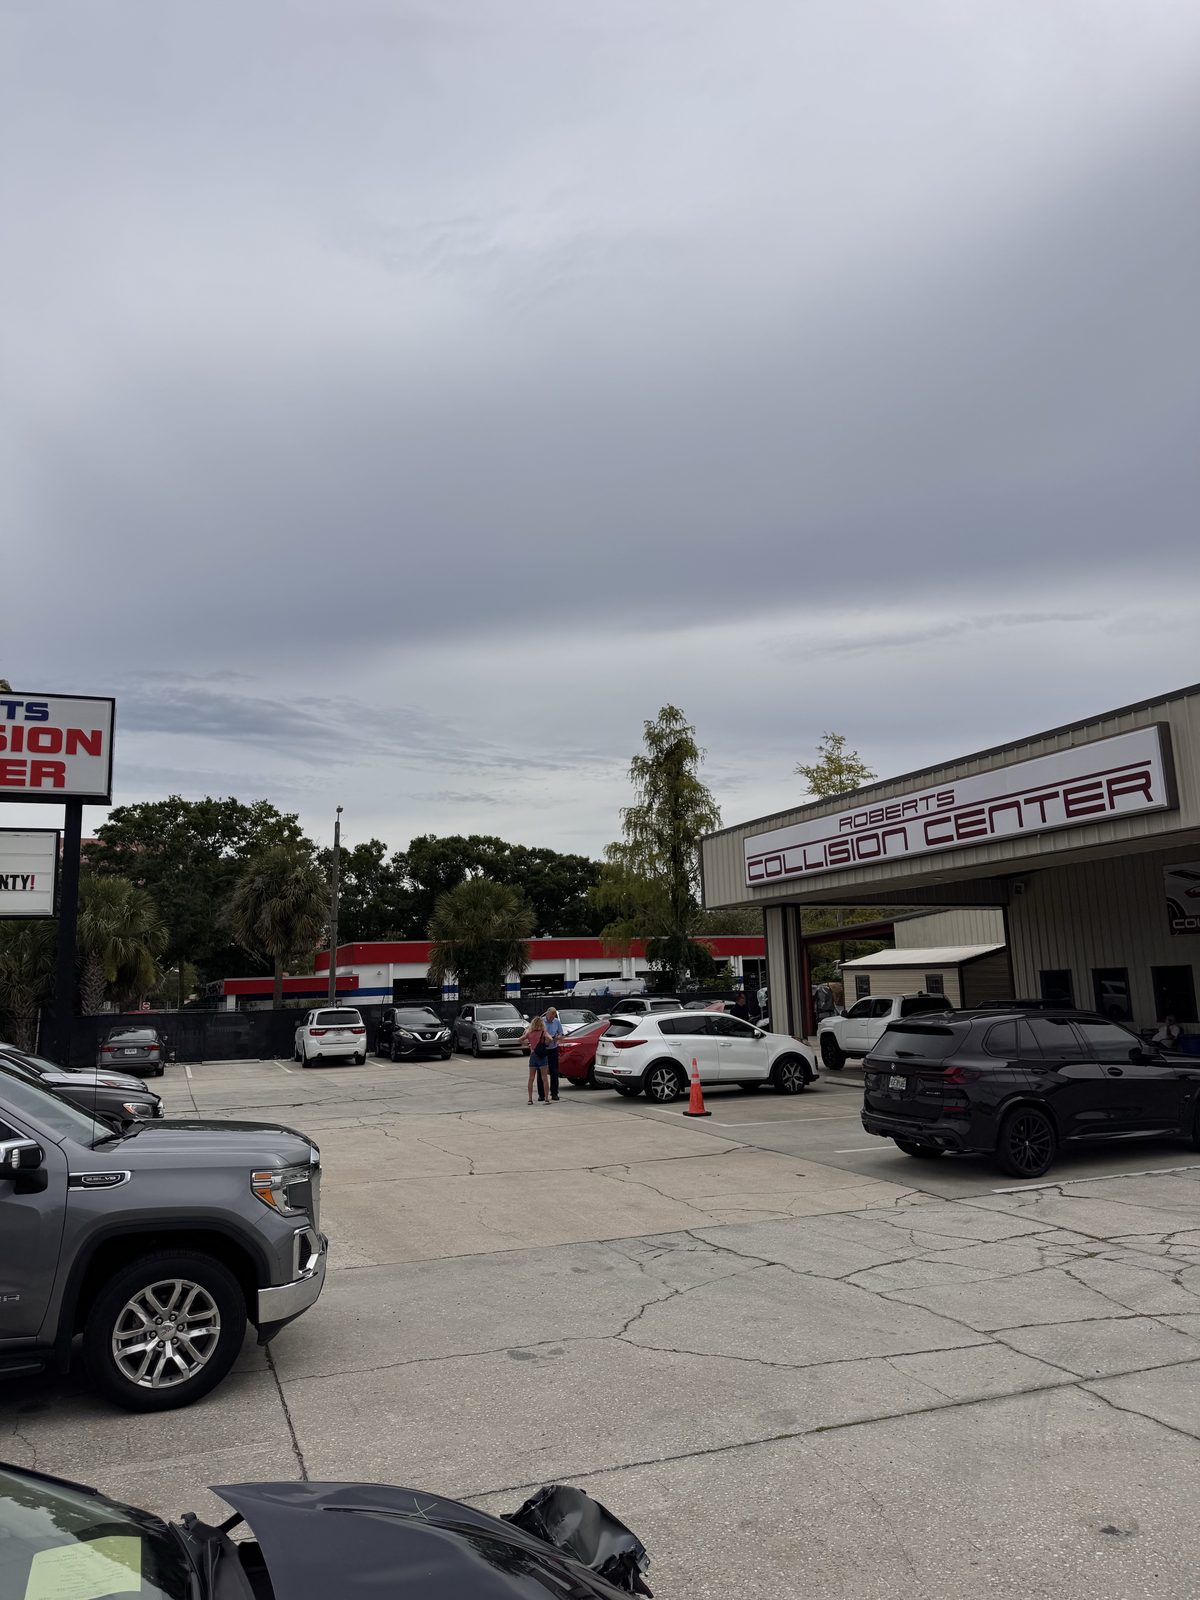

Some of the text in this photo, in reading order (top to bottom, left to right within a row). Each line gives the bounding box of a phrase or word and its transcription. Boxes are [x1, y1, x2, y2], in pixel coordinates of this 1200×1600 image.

[0, 700, 49, 721] TS
[0, 725, 102, 756] ION
[0, 759, 66, 788] ER
[747, 770, 1154, 881] COLLISION CENTER
[839, 789, 955, 832] ROBERTS
[0, 875, 35, 890] NTY!
